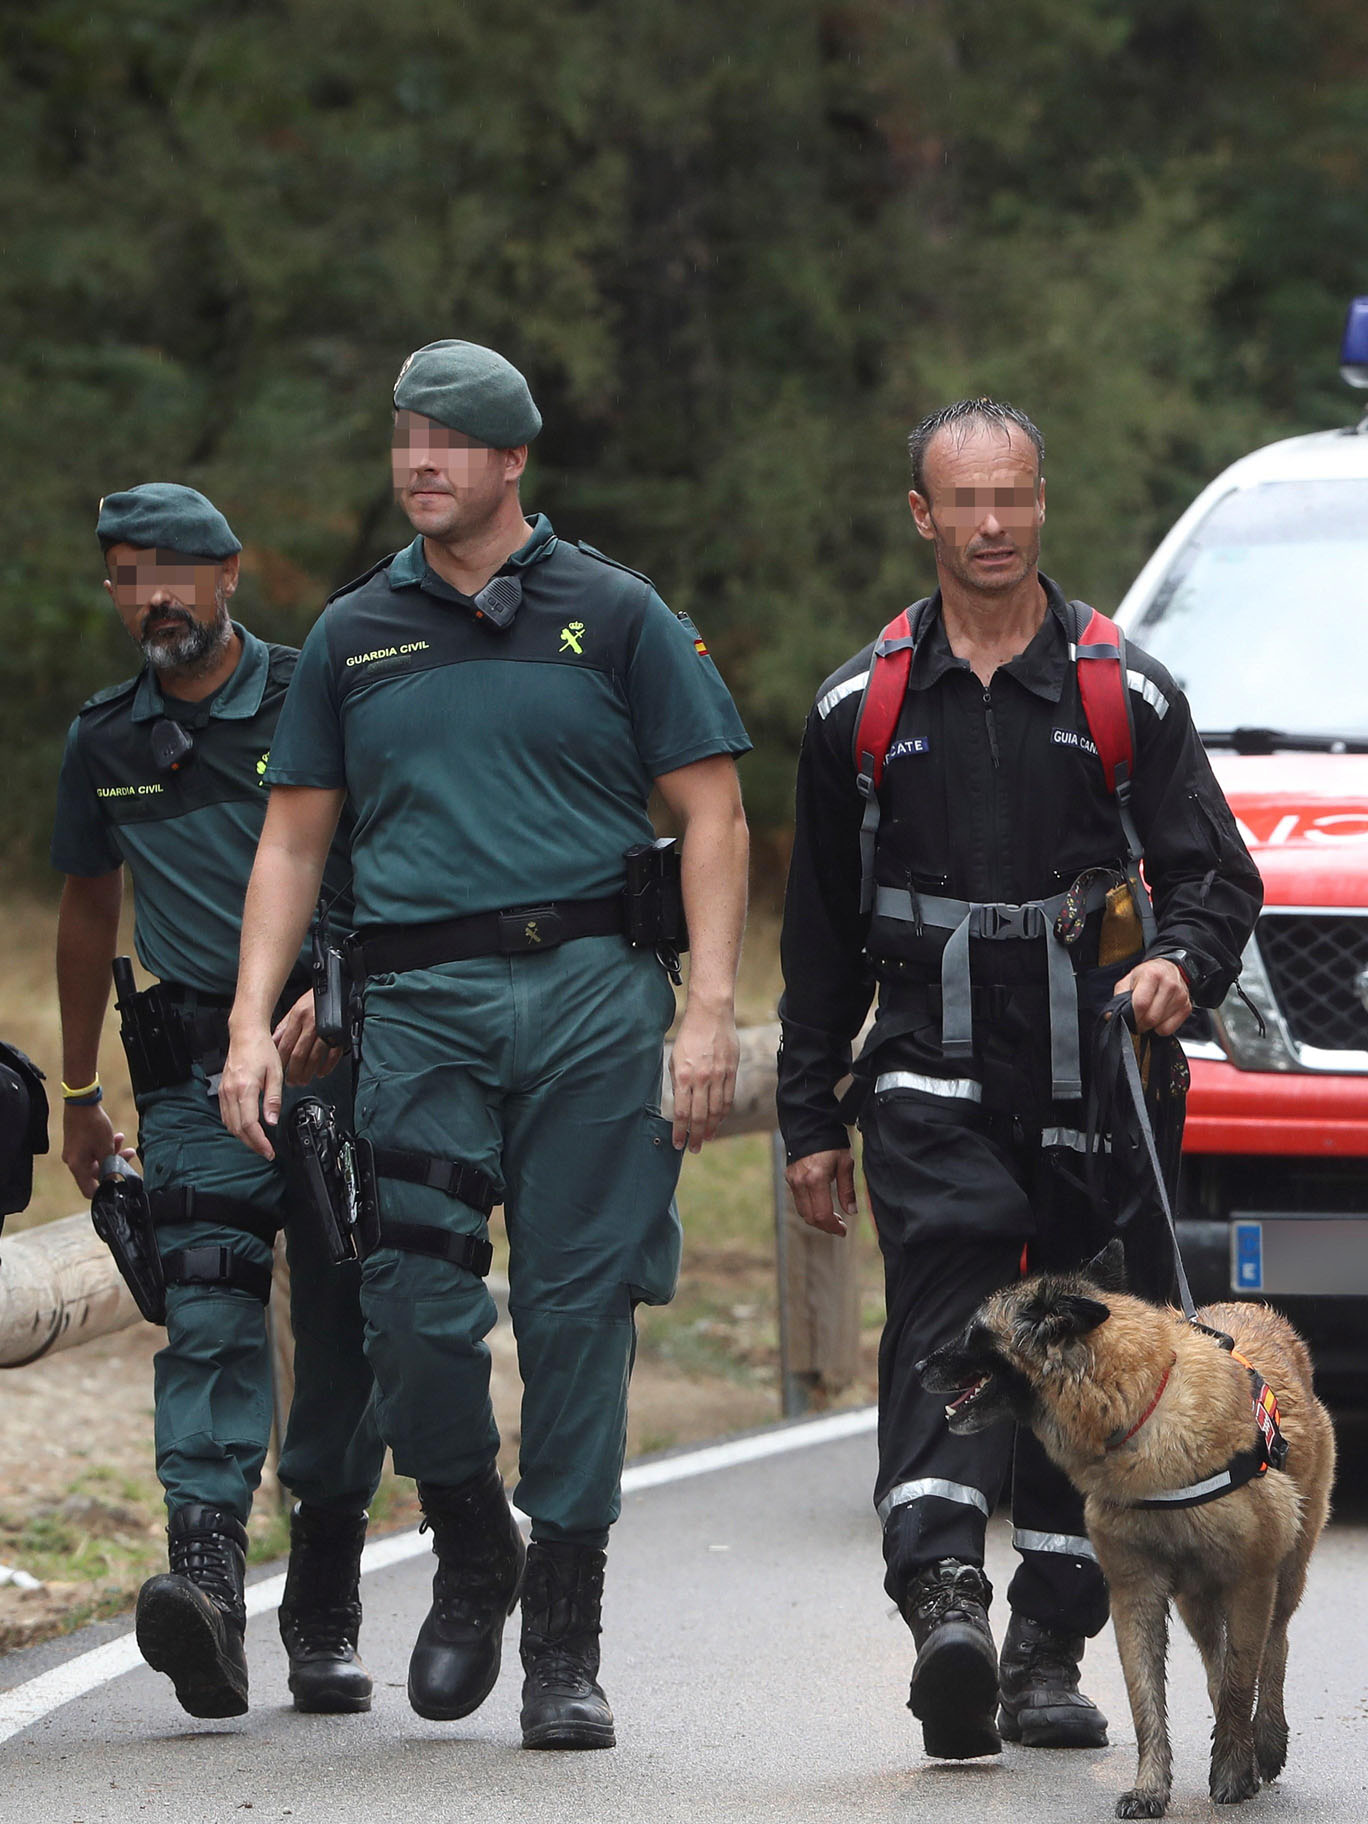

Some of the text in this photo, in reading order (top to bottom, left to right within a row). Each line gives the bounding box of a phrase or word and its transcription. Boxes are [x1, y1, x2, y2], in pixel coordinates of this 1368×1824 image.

[346, 640, 430, 667] GUARDIA CIVIL
[884, 740, 924, 765] CATE
[1053, 730, 1098, 755] GUIA CAN
[96, 783, 164, 797] GUARDIA CIVIL
